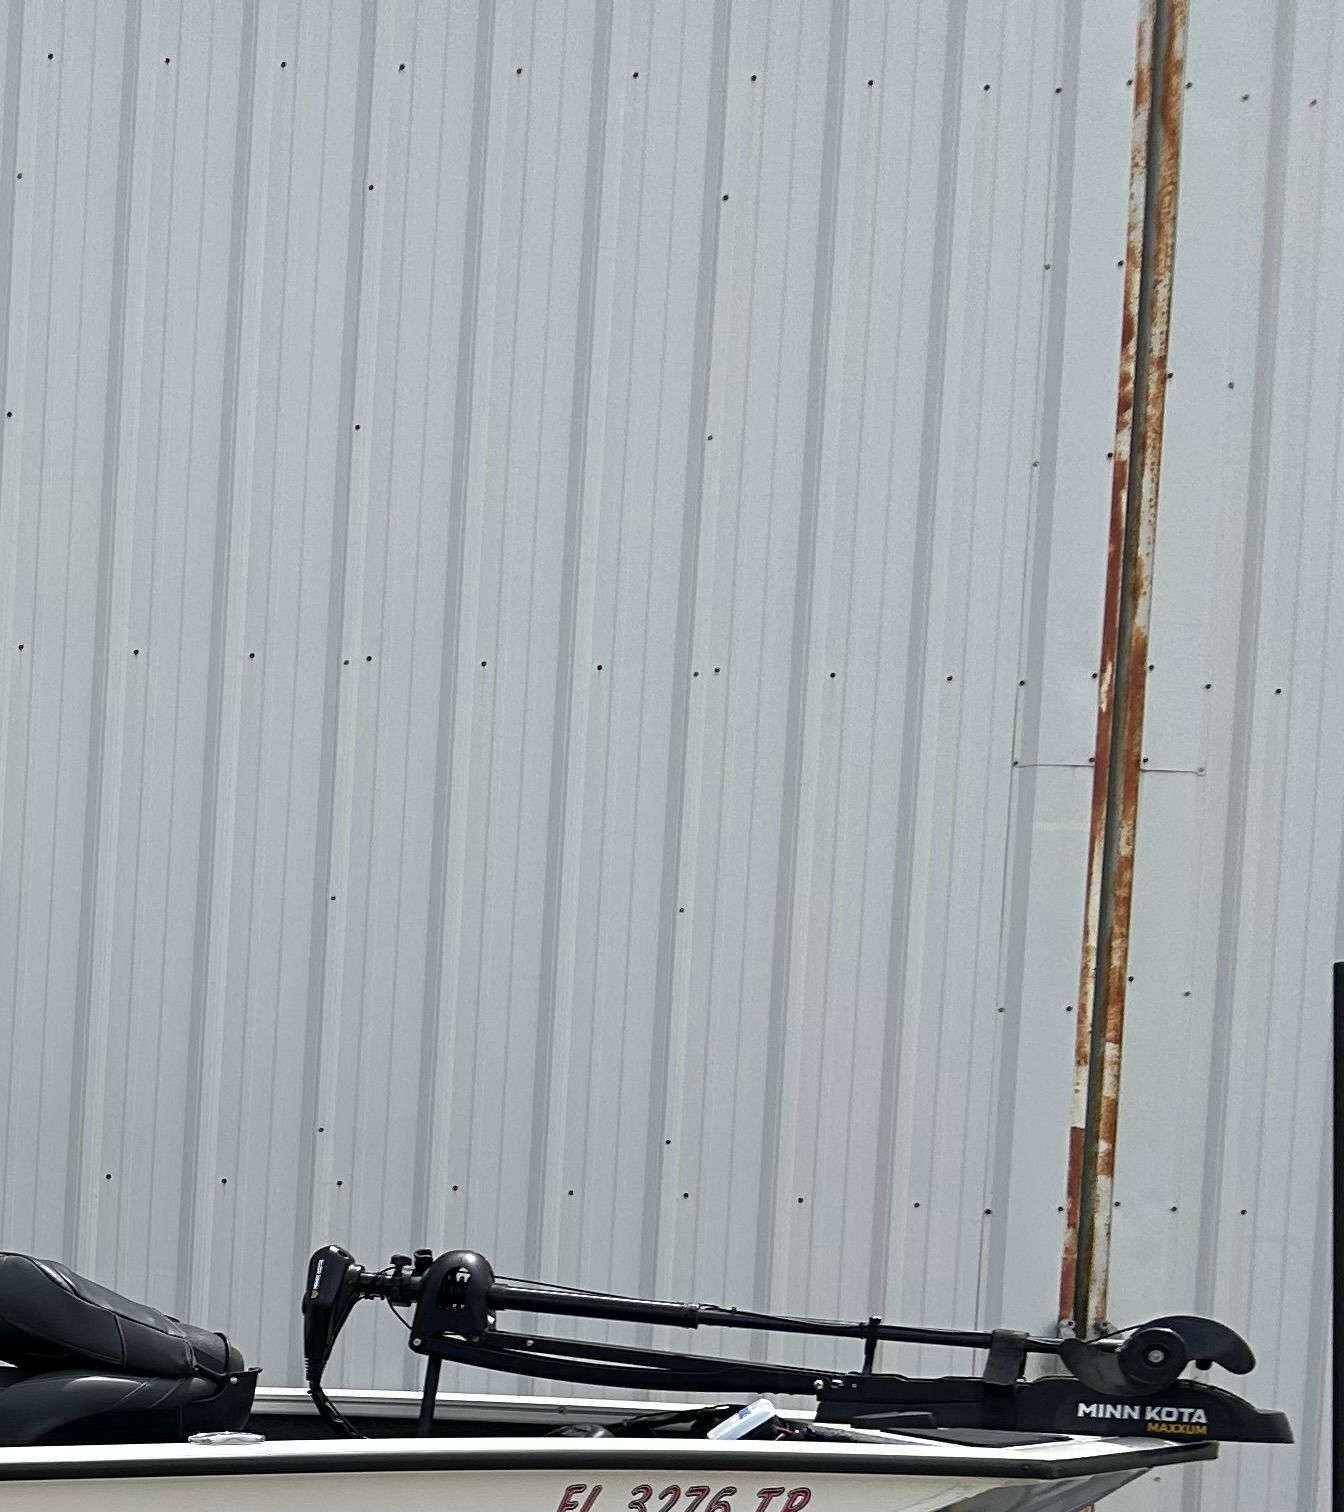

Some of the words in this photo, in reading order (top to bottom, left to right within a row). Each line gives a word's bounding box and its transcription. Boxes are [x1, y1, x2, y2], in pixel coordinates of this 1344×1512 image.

[1076, 1402, 1141, 1420] MINN
[1144, 1406, 1208, 1423] KOTA
[1146, 1422, 1208, 1435] MAXXUM
